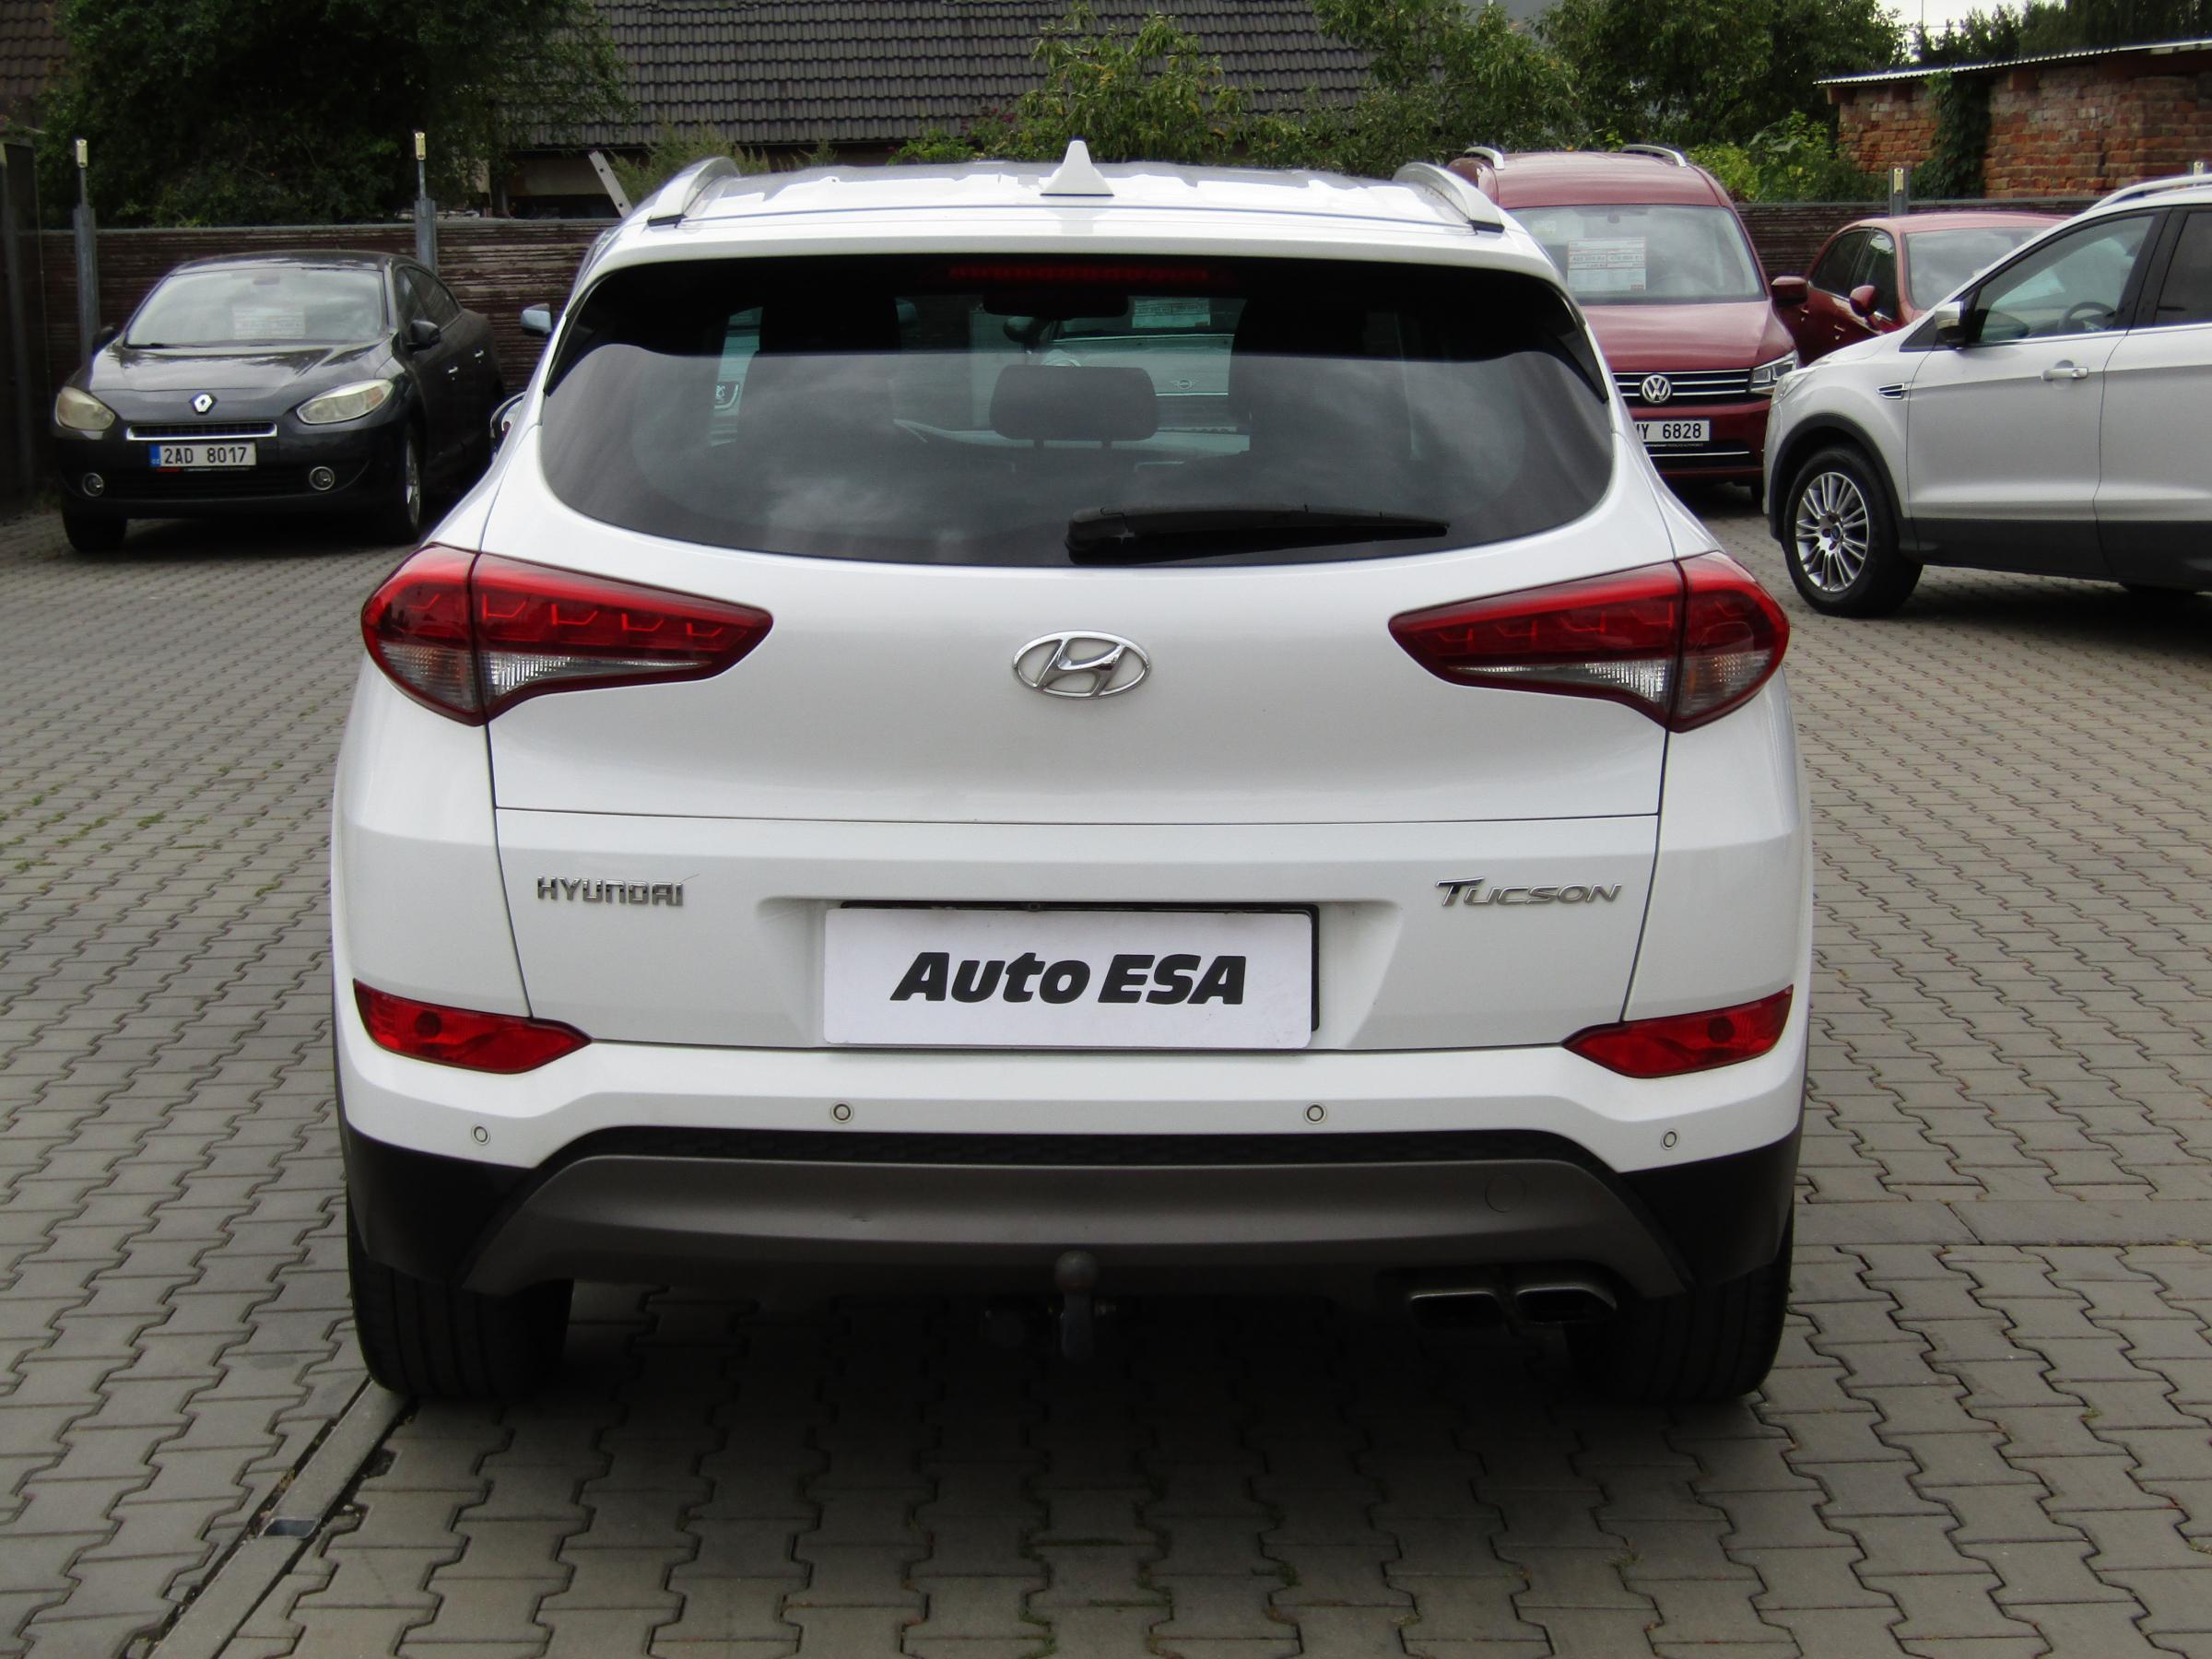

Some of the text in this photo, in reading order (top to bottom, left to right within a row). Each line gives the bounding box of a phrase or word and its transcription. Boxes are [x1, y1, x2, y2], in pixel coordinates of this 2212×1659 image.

[1636, 423, 1701, 440] Y 6828
[164, 446, 247, 464] 2AD 8017
[537, 876, 684, 906] HYUNDAI
[889, 952, 1247, 1006] Auto ESA
